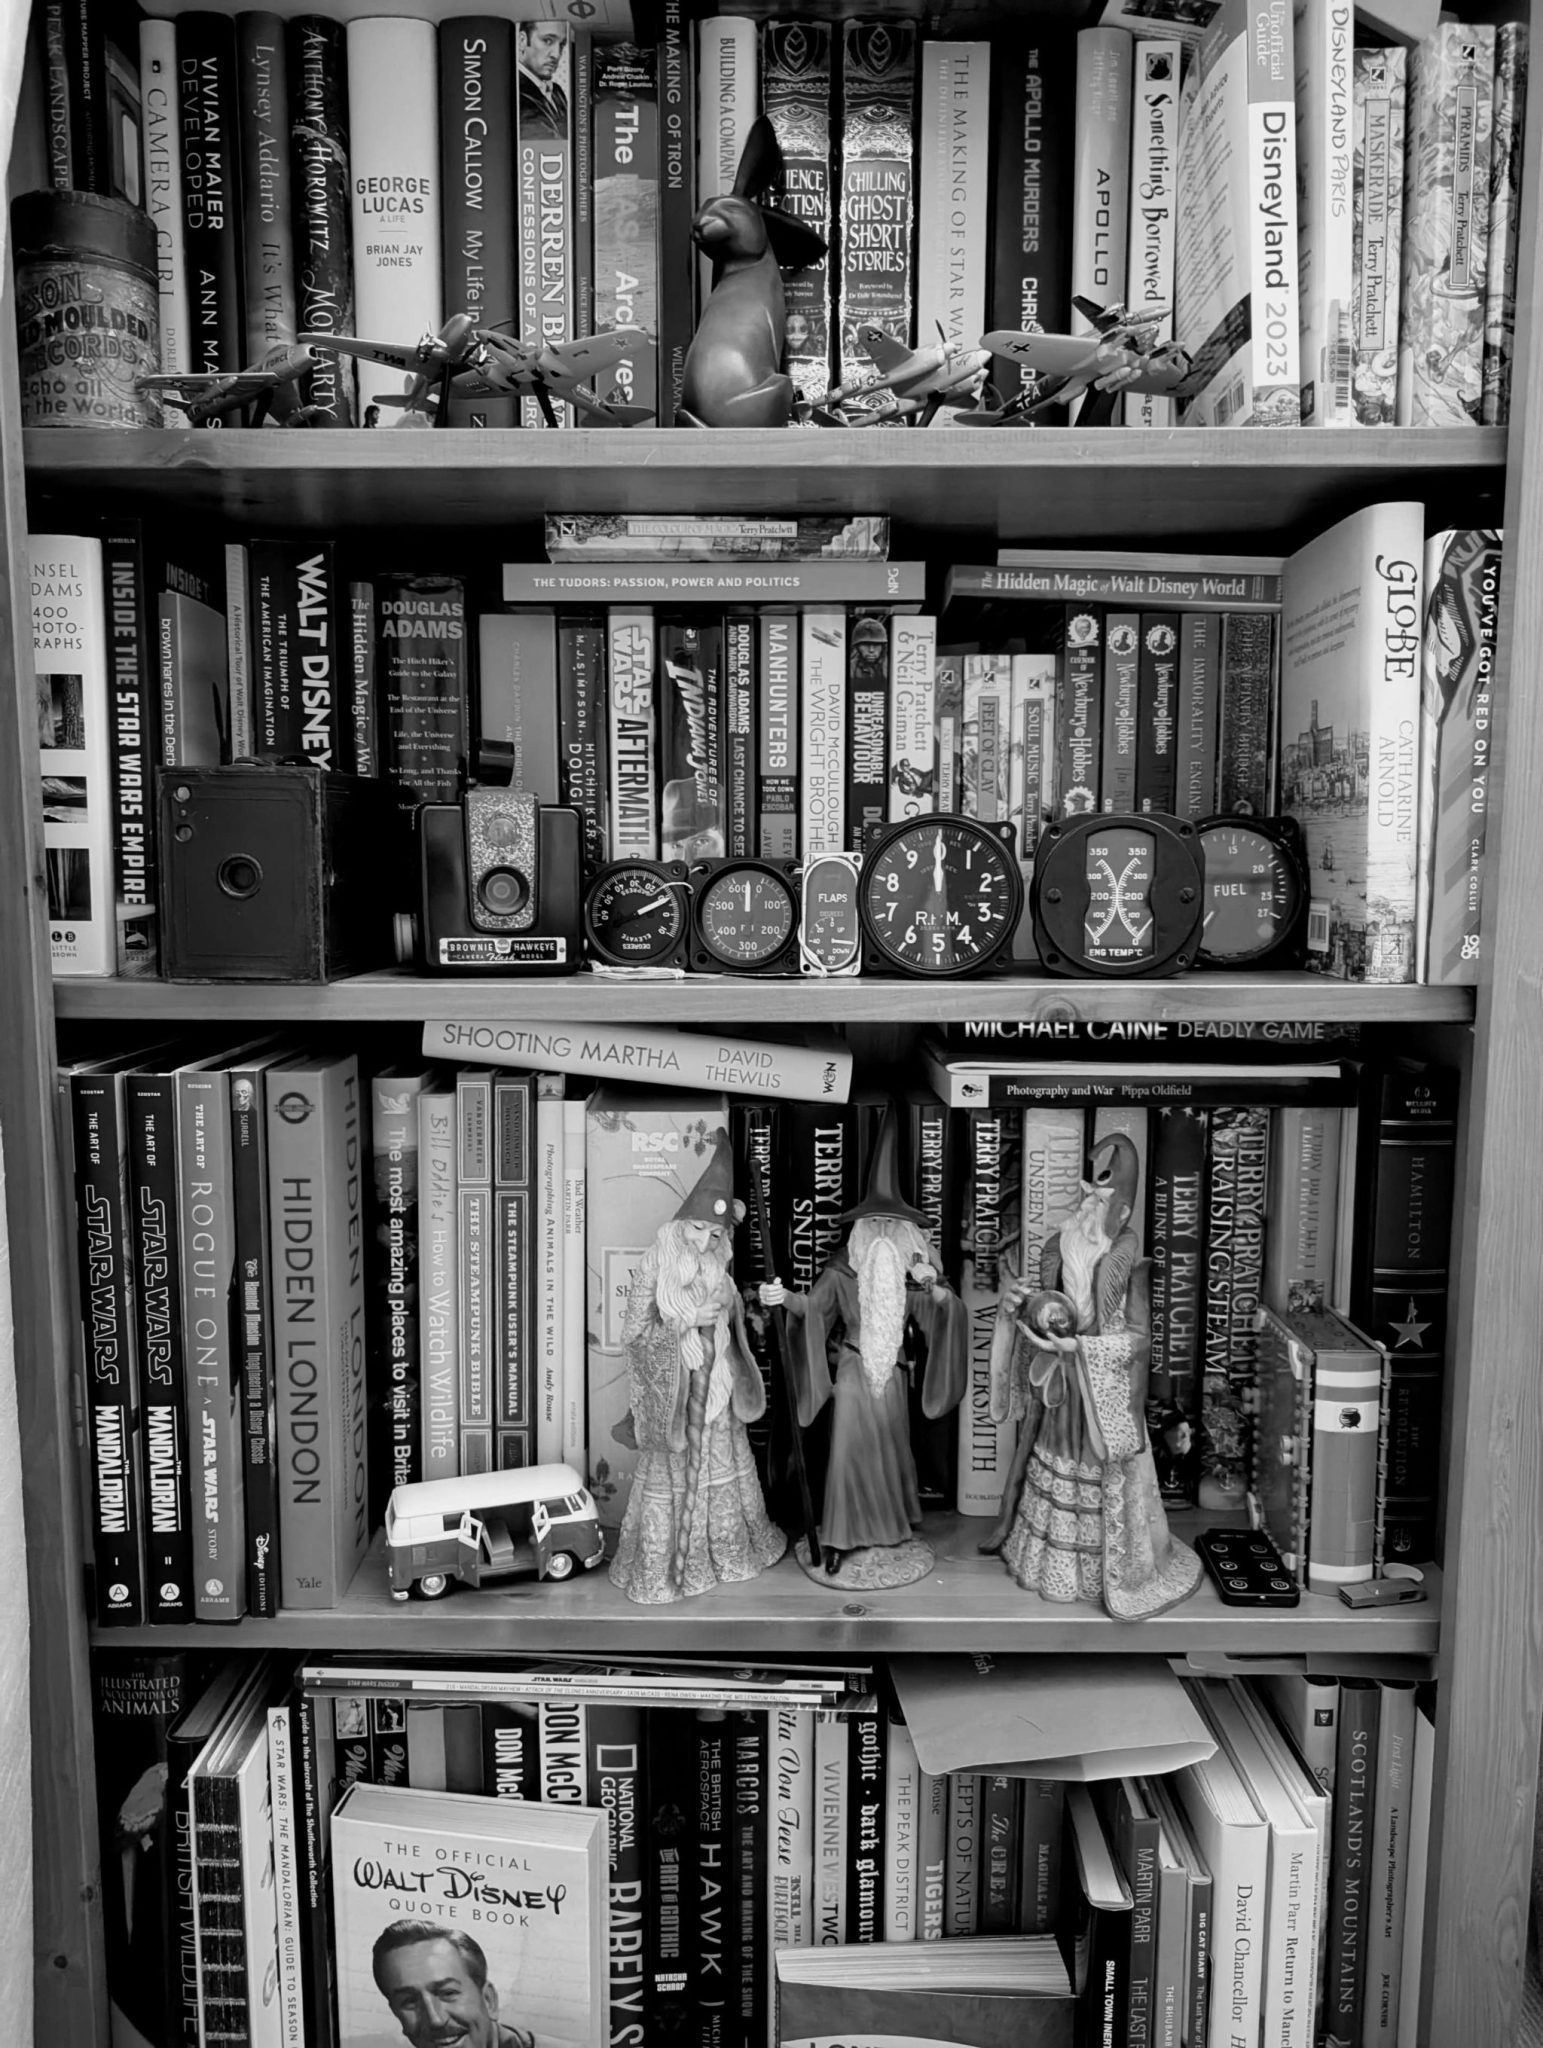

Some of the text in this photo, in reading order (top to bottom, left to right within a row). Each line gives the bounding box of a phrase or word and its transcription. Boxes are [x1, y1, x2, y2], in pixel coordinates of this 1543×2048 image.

[147, 88, 170, 215] CAMERA
[181, 58, 202, 229] DEVELOPED
[202, 57, 224, 230] VIVIAN MAIER
[252, 44, 278, 223] Lynsey Addario
[463, 39, 486, 210] SIMON CALLOW
[614, 106, 639, 165] The
[665, 29, 681, 189] MAKING OF TRON
[1329, 8, 1350, 218] DISNEYLAND PARIS
[305, 140, 333, 251] HOROWITZ
[356, 178, 431, 195] GEORGE
[361, 198, 424, 213] LUCAS
[847, 171, 905, 193] CHILLING
[847, 195, 904, 222] GHOST
[950, 56, 969, 301] THE MAKING OF STAR
[1023, 74, 1042, 253] APOLLO MURDERS
[1139, 93, 1172, 301] Something Borrowed
[1455, 106, 1473, 267] PYRAMIDS Terry Pratchett
[366, 245, 424, 256] BRIAN JAY
[376, 257, 413, 266] JONES
[540, 153, 565, 306] DERREN
[847, 251, 904, 272] STORIES
[848, 225, 903, 250] SHORT
[1095, 168, 1111, 286] APOLLO
[1260, 111, 1289, 378] Disneyland 2023
[1366, 114, 1387, 337] MASKERADE Terry Pratchett
[382, 602, 463, 617] DOUGLAS
[533, 576, 800, 588] THE TUDORS: PASSION, POWER AND POLITICS
[996, 573, 1245, 598] Hidden Magic Walt Disney World
[260, 576, 275, 746] THE AMERICAN IMAGINATION
[277, 614, 290, 710] THE TRIUMPH OF
[296, 554, 332, 771] WALT DISNEY
[383, 621, 463, 639] ADAMS
[161, 618, 176, 735] brown hares in the
[769, 624, 787, 768] MANHUNTERS
[1471, 564, 1496, 814] YOU'VE GOT RED ON YOU
[111, 561, 145, 904] INSIDE THE STAR WARS EMPIRE
[853, 692, 870, 784] BEHAVIOUR
[870, 692, 884, 784] UNREASONABLE
[617, 719, 650, 845] AFTERMATH
[1378, 737, 1394, 828] ARNOLD
[1396, 719, 1414, 841] CATHARINE
[818, 893, 847, 903] FLAPS
[1214, 885, 1246, 897] FUEL
[1469, 838, 1480, 911] CLARK COLLIS
[449, 943, 494, 952] BROWNIE
[514, 942, 555, 952] HAWKEYE
[442, 1025, 680, 1070] SHOOTING MARTHA
[717, 1047, 774, 1068] DAVID
[1178, 1021, 1325, 1039] DEADLY GAME
[704, 1065, 781, 1089] THEWLIS
[1006, 1085, 1114, 1097] Photography and War
[1121, 1084, 1192, 1098] Pippa Oldfield
[85, 1185, 120, 1385] STAR WARS
[190, 1182, 218, 1386] ROGUE ONE
[388, 1126, 410, 1439] The most amazing places to visit in
[507, 1201, 518, 1416] THE STEAMPUNK USER'S MANUAL
[1206, 1156, 1235, 1374] RAISING STEAM
[282, 1177, 321, 1504] HIDDEN LONDON
[95, 1405, 126, 1532] MANDALORIAN
[296, 1577, 322, 1590] Yale
[275, 1740, 285, 1767] STAR
[736, 1736, 760, 1815] NARCOS
[278, 1816, 288, 1838] THE
[384, 1842, 532, 1871] THE OFFICIAL
[895, 1775, 911, 1931] THE PEAK DISTRICT
[1338, 1731, 1368, 2014] SCOTLAND'S MOUNTAINS
[389, 1899, 531, 1928] QUOTE BOOK
[699, 1843, 722, 1975] HAWK
[924, 1859, 943, 1940] TIGERS
[1133, 1848, 1154, 1944] MARTIN PARR
[1198, 1930, 1206, 1949] CAT
[285, 1937, 294, 1970] GUIDE
[287, 1976, 296, 1990] TO
[1197, 1951, 1205, 1979] DIARY
[1231, 1884, 1253, 2023] David Chancellor
[288, 1995, 298, 2041] SEASON
